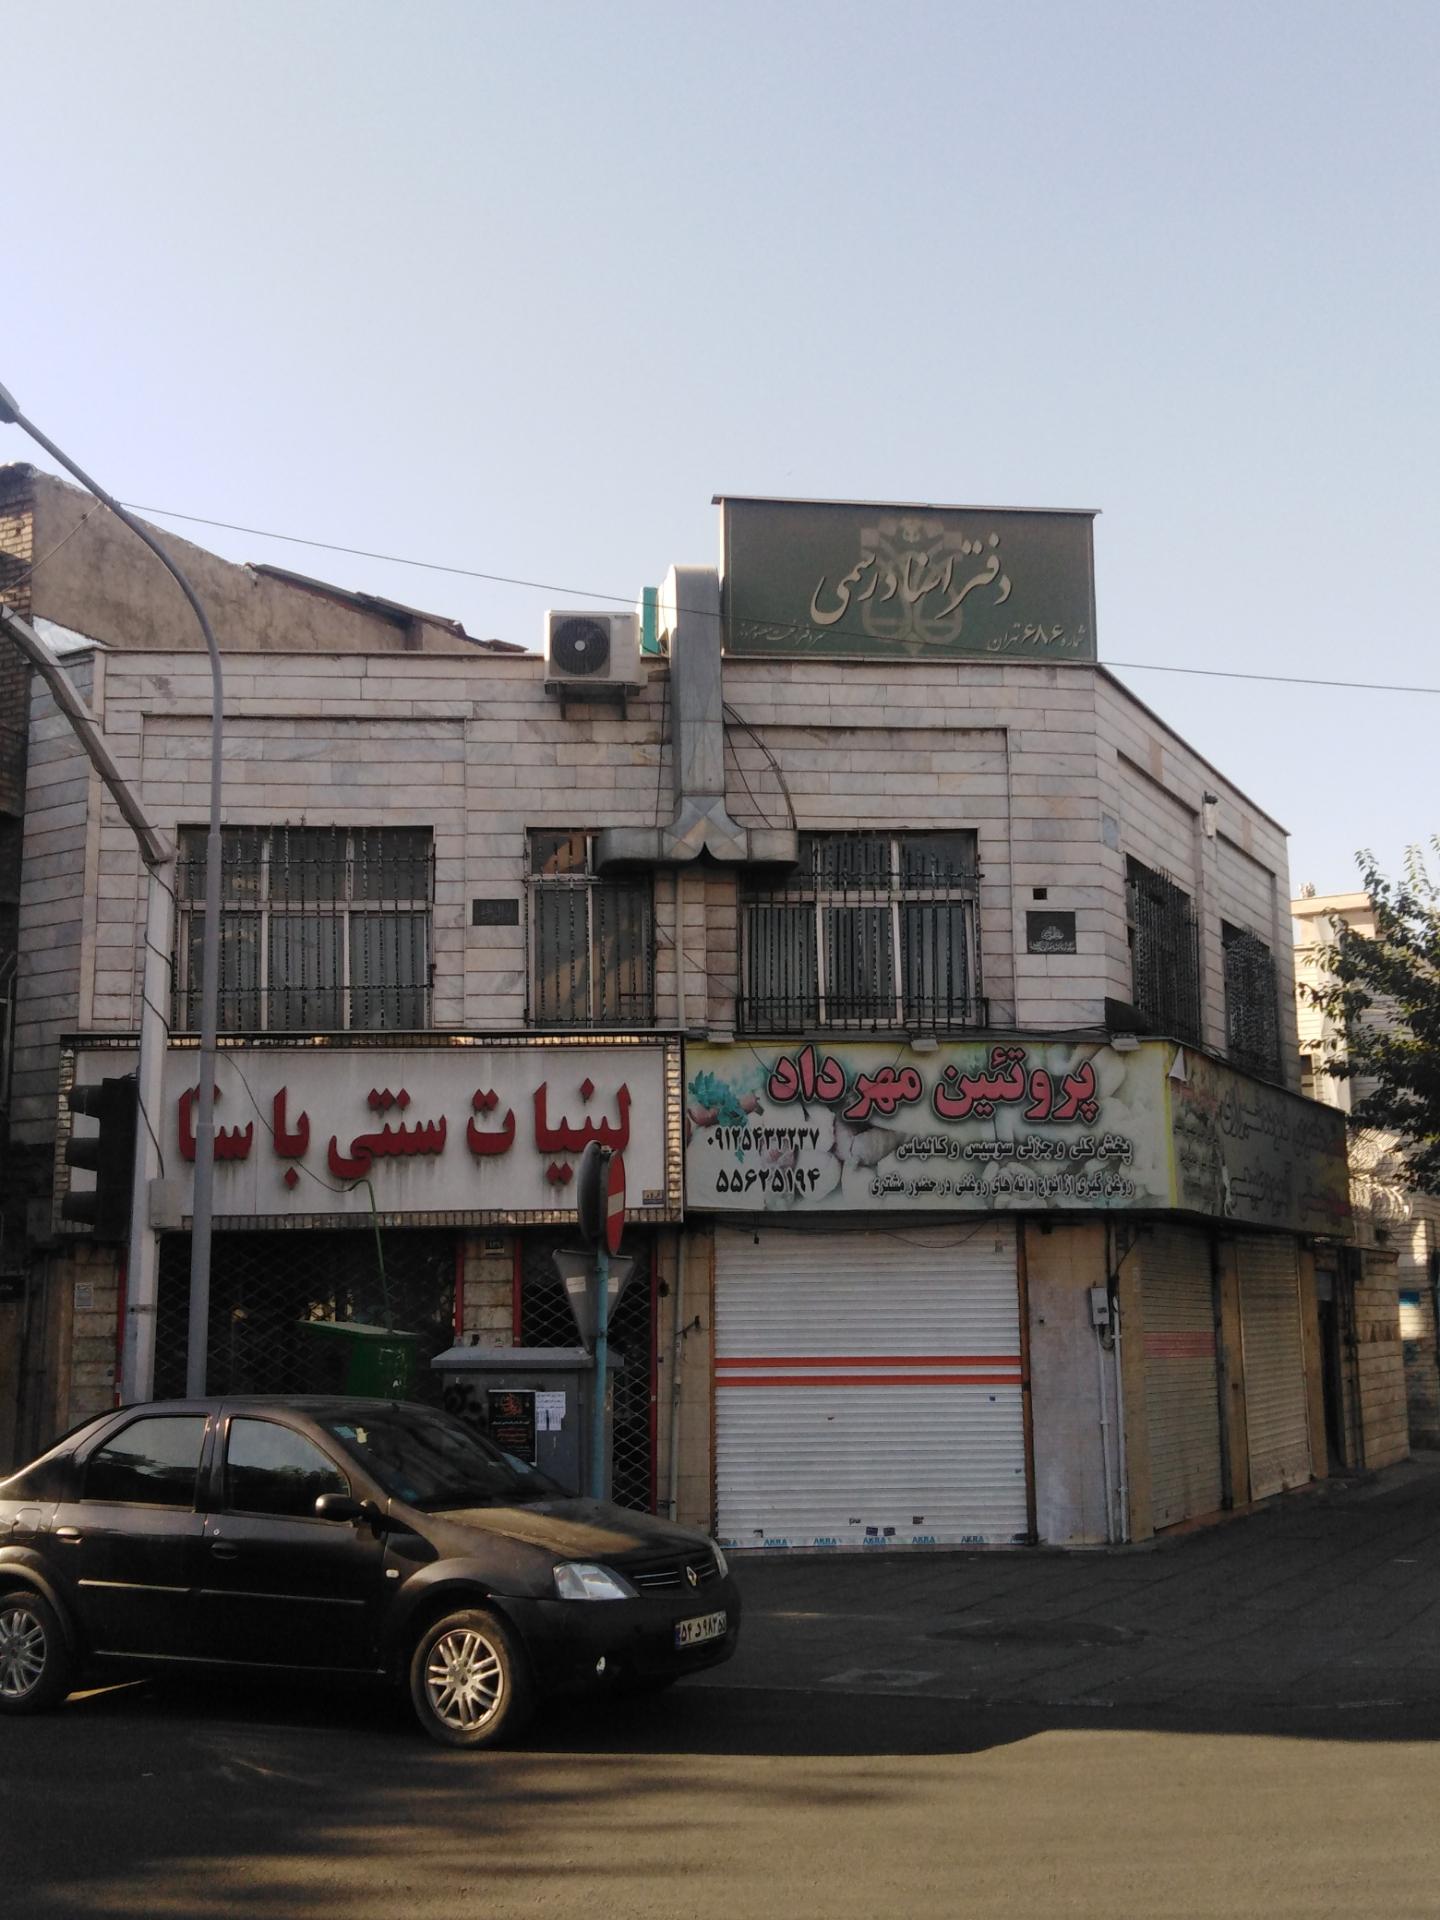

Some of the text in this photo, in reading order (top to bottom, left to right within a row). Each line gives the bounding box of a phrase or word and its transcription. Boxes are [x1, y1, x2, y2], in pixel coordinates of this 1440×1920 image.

[810, 532, 1012, 625] دفتر اسناد رسمی
[986, 623, 1086, 651] شماره ۶۸۶ تهران
[768, 1043, 1101, 1124] پروتئین مهرداد
[328, 1087, 447, 1180] سنتی
[707, 1126, 820, 1151] ۰۹۱۲۵۴۳۳۲۳۷
[897, 1136, 947, 1160] کالباس
[948, 1143, 959, 1160] و
[963, 1142, 1013, 1160] سوسیس
[1054, 1144, 1065, 1160] و
[1069, 1136, 1095, 1159] کلی
[1098, 1135, 1133, 1164] پخش
[716, 1168, 821, 1193] ۵۵۶۲۵۱۹۴
[871, 1171, 1135, 1198] روغن گیری از انواع دانه های روغنی در حضور مشتری
